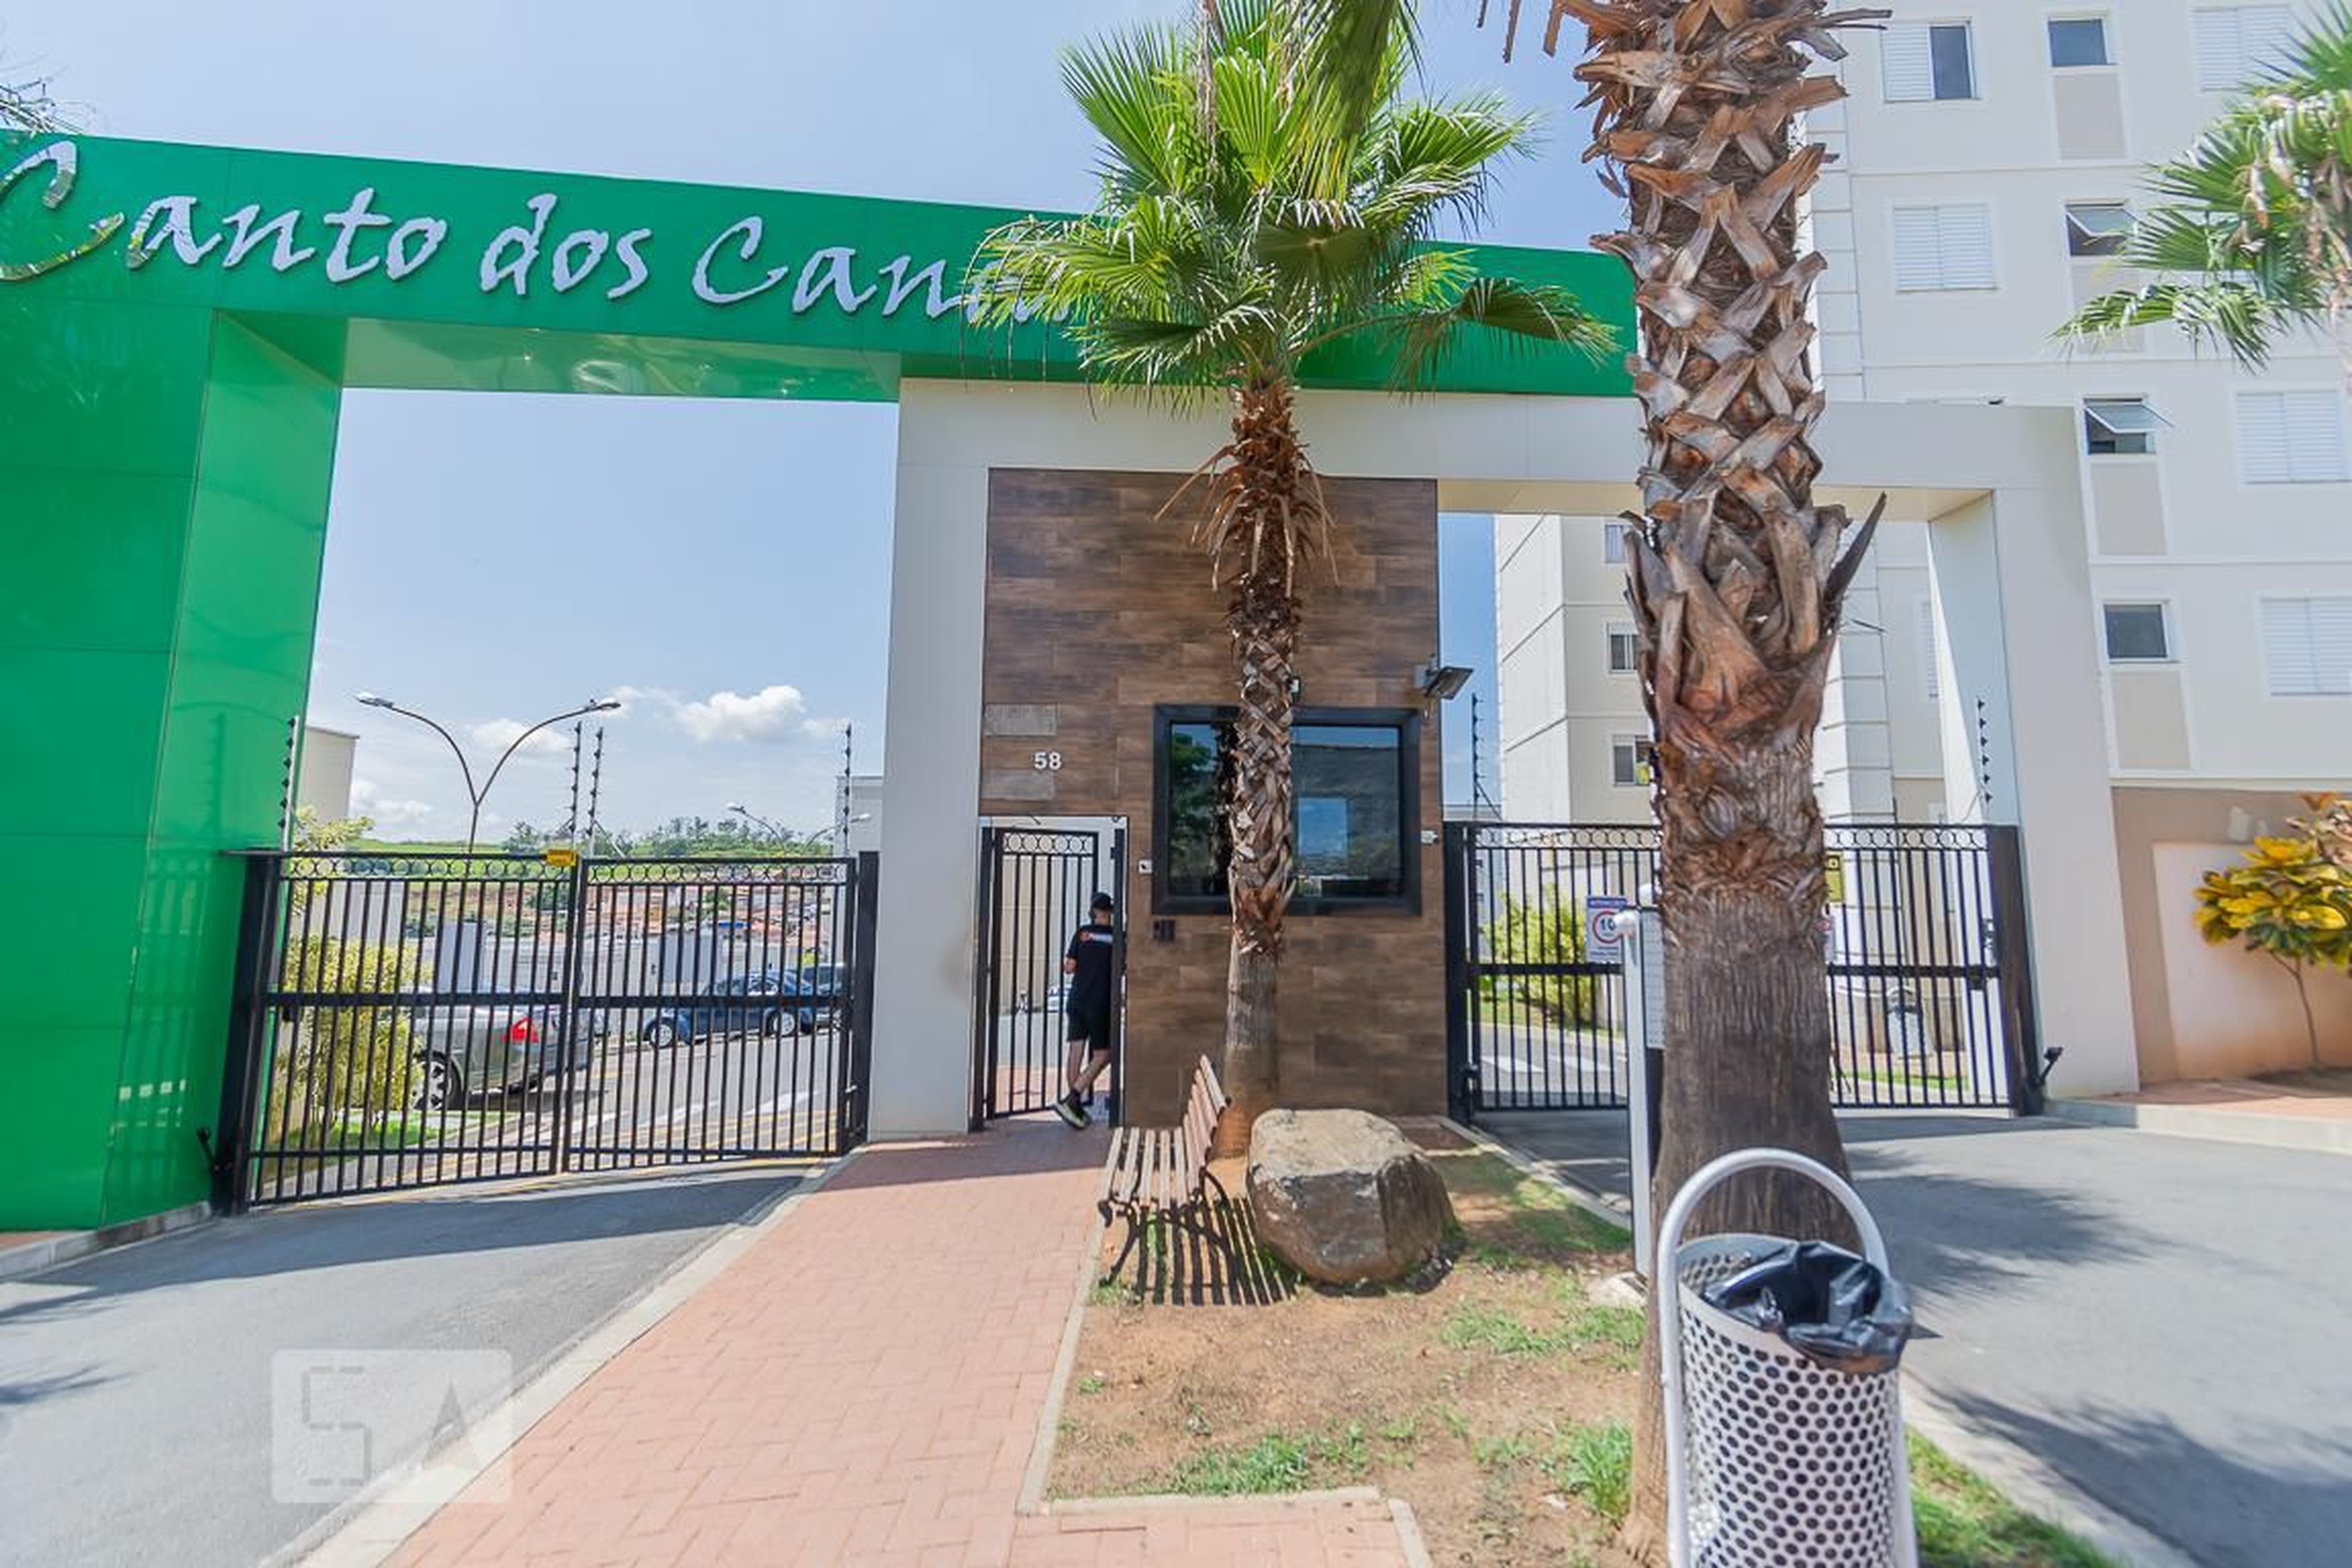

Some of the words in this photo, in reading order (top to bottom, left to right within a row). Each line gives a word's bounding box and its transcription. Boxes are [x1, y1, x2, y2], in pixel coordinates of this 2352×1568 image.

[0, 140, 448, 284] Canto
[479, 192, 653, 299] dos
[1034, 752, 1062, 770] 58
